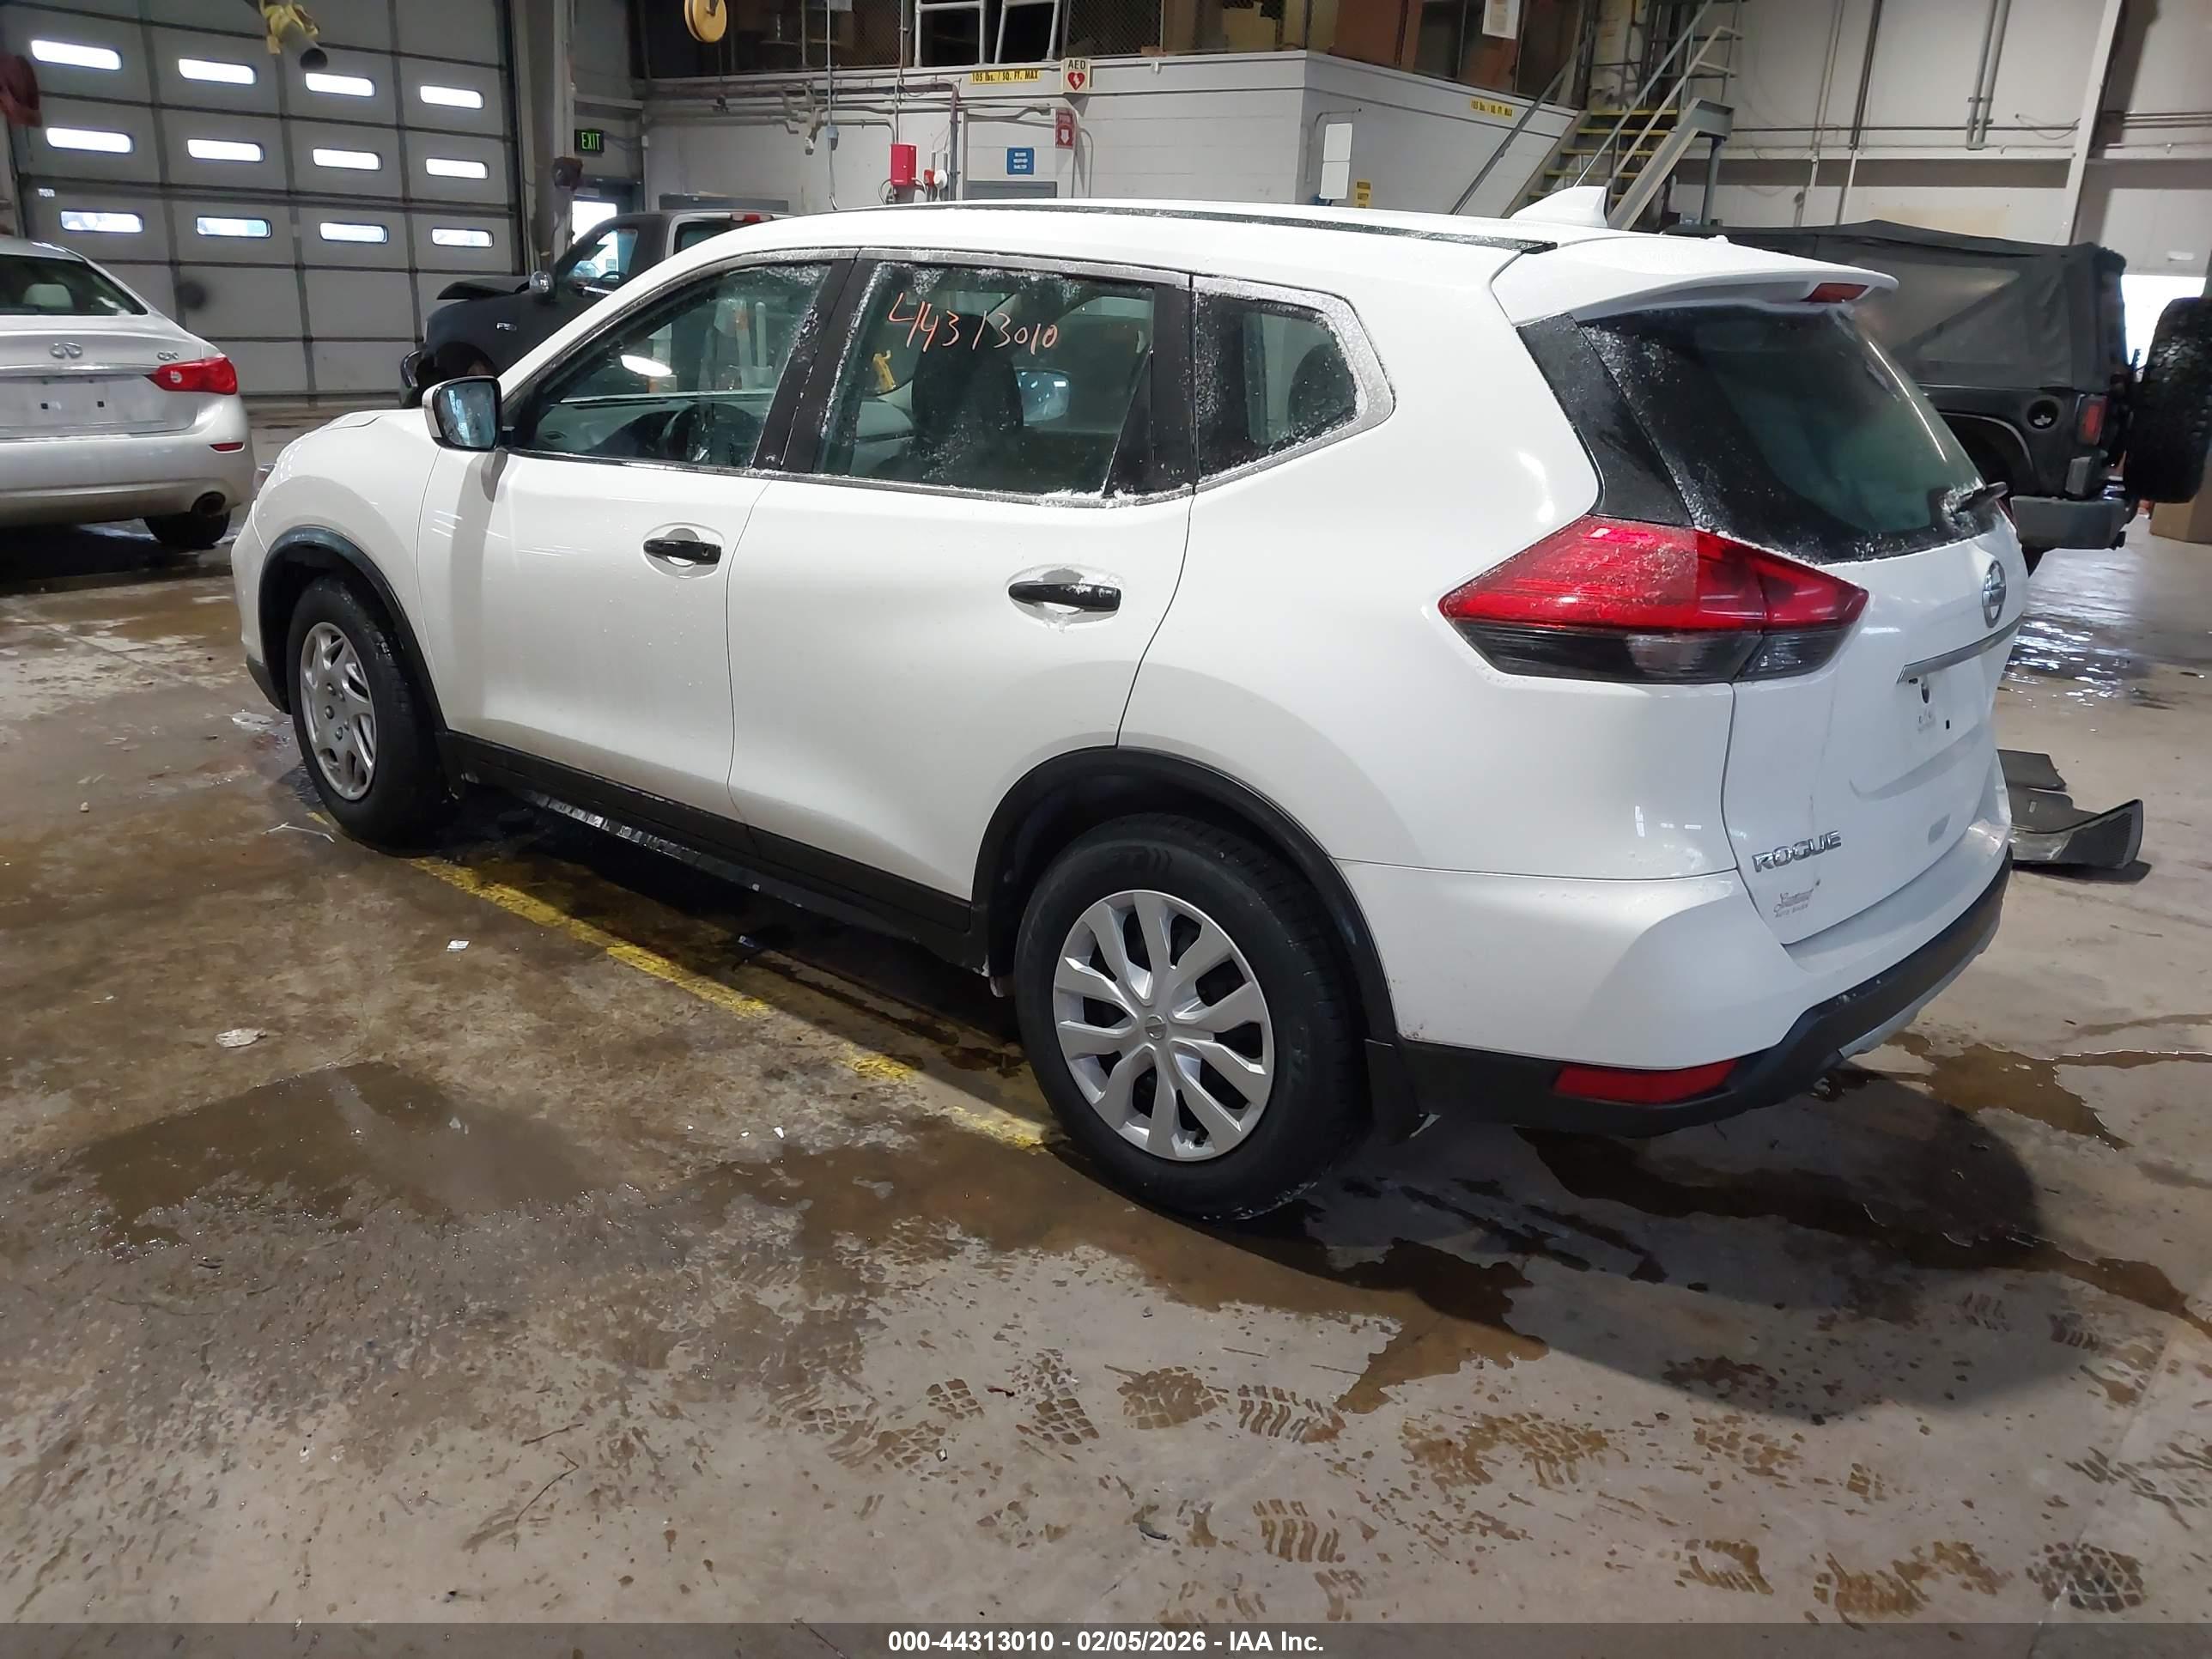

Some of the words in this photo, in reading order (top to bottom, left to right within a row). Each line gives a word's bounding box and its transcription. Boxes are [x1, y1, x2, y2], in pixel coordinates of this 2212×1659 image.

[1067, 59, 1086, 70] AED
[972, 72, 983, 82] 105
[1024, 70, 1038, 80] MAX
[581, 131, 601, 151] EXIT
[1752, 830, 1842, 873] ROGUE
